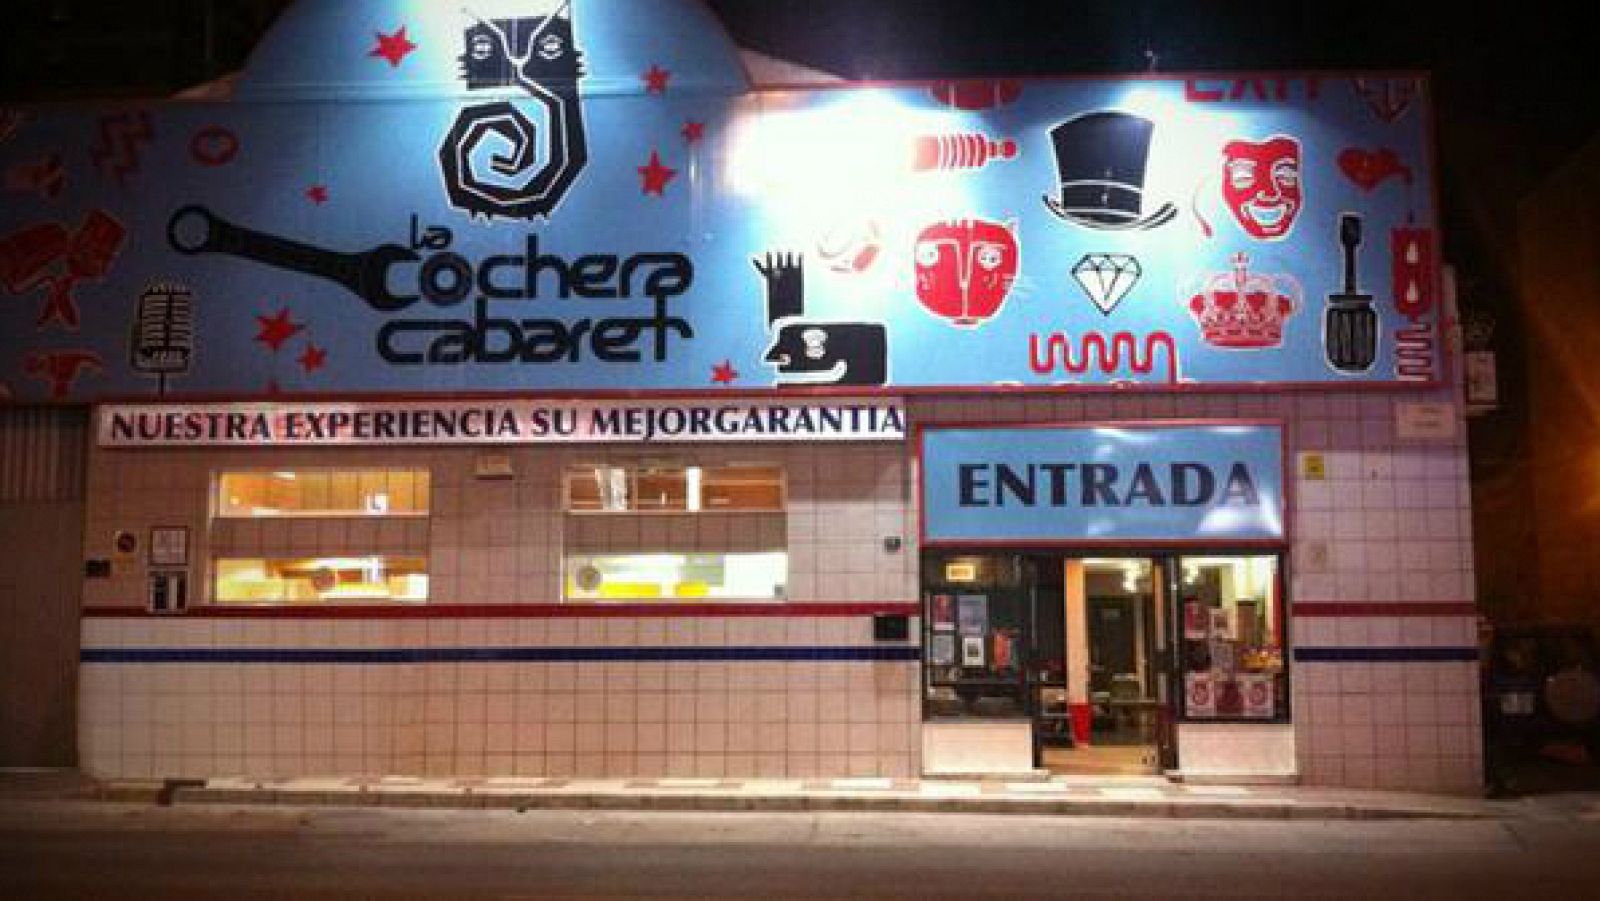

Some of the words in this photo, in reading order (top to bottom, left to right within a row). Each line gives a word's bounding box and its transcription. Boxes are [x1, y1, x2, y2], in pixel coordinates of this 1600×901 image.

[409, 211, 453, 250] la
[376, 296, 694, 364] cabaret
[111, 412, 271, 440] NUESTRA
[285, 407, 520, 439] EXPERIENCIA
[532, 407, 577, 436] SU
[958, 461, 1263, 507] ENTRADA
